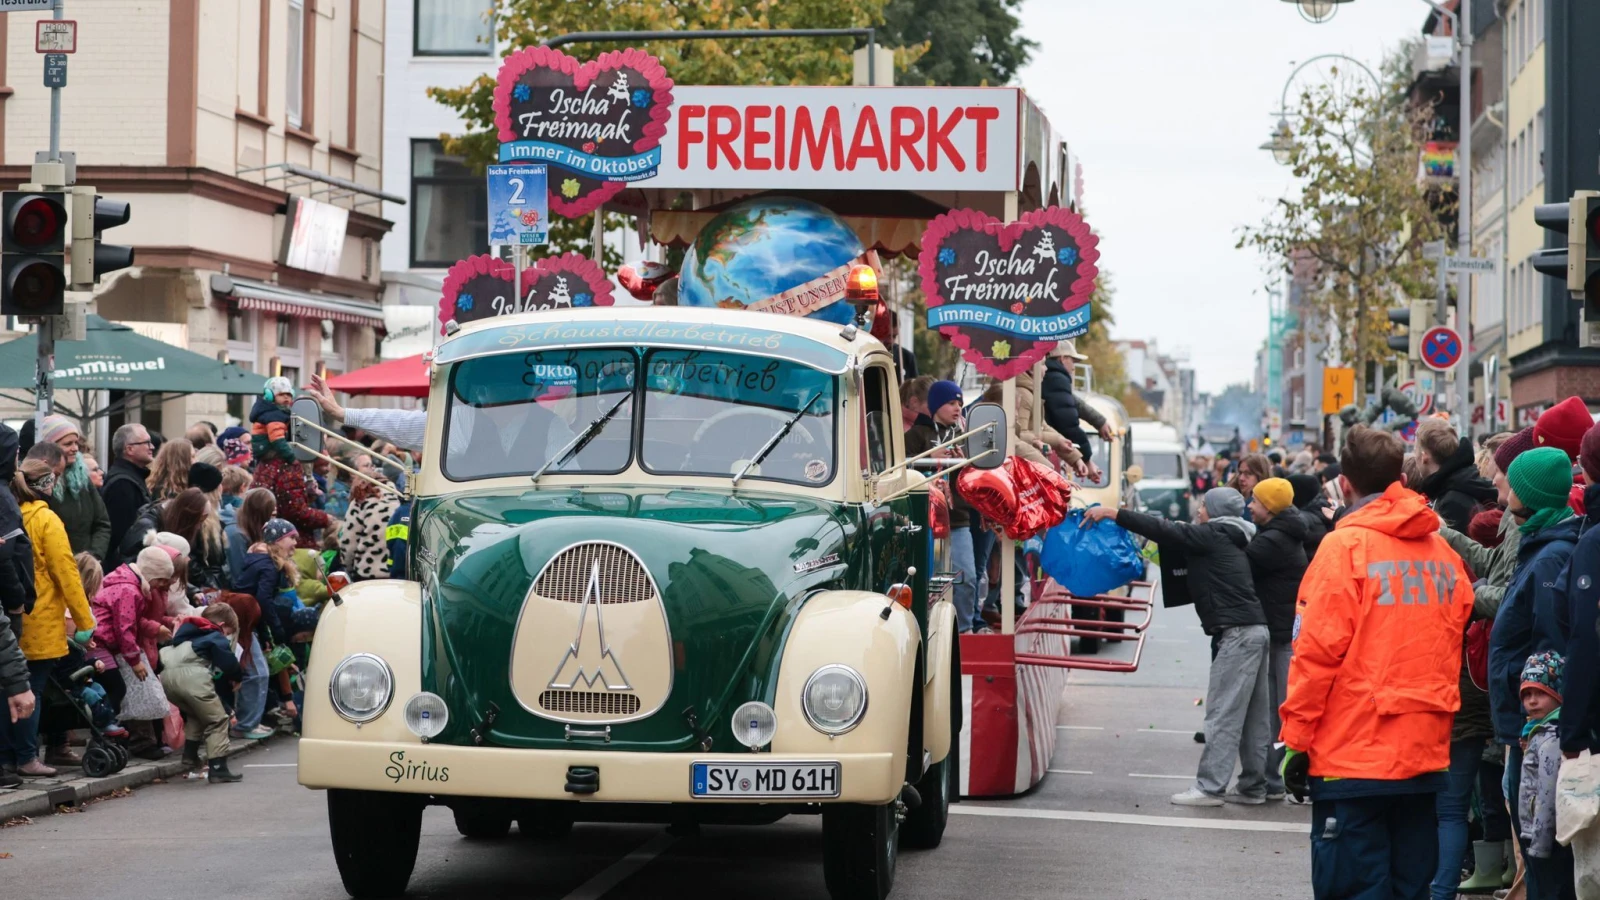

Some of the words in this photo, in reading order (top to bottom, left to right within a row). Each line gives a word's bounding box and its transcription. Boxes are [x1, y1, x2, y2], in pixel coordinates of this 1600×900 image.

[549, 83, 610, 115] Ischa
[518, 109, 632, 144] Freimaak
[677, 104, 1000, 173] FREIMARKT
[508, 167, 546, 175] Freimaak!
[510, 143, 565, 160] immer
[566, 150, 586, 169] im
[590, 153, 654, 174] Oktober
[608, 170, 656, 182] www.freimarkt.de
[508, 177, 527, 205] 2
[974, 244, 1036, 276] Ischa
[797, 277, 845, 309] UNSER
[944, 267, 1060, 302] Freimaak
[491, 289, 551, 317] Isha
[938, 308, 992, 322] immer
[995, 312, 1015, 330] im
[1020, 311, 1084, 333] Oktober
[1039, 327, 1088, 341] www.freimarkt.de
[498, 321, 783, 349] Schaustellerbetrieb
[44, 357, 165, 379] anMiguel
[1330, 375, 1339, 384] U
[1367, 560, 1457, 606] THW
[385, 750, 450, 784] Sirius
[708, 768, 739, 791] SY
[755, 768, 786, 791] MD
[791, 768, 836, 791] 61H
